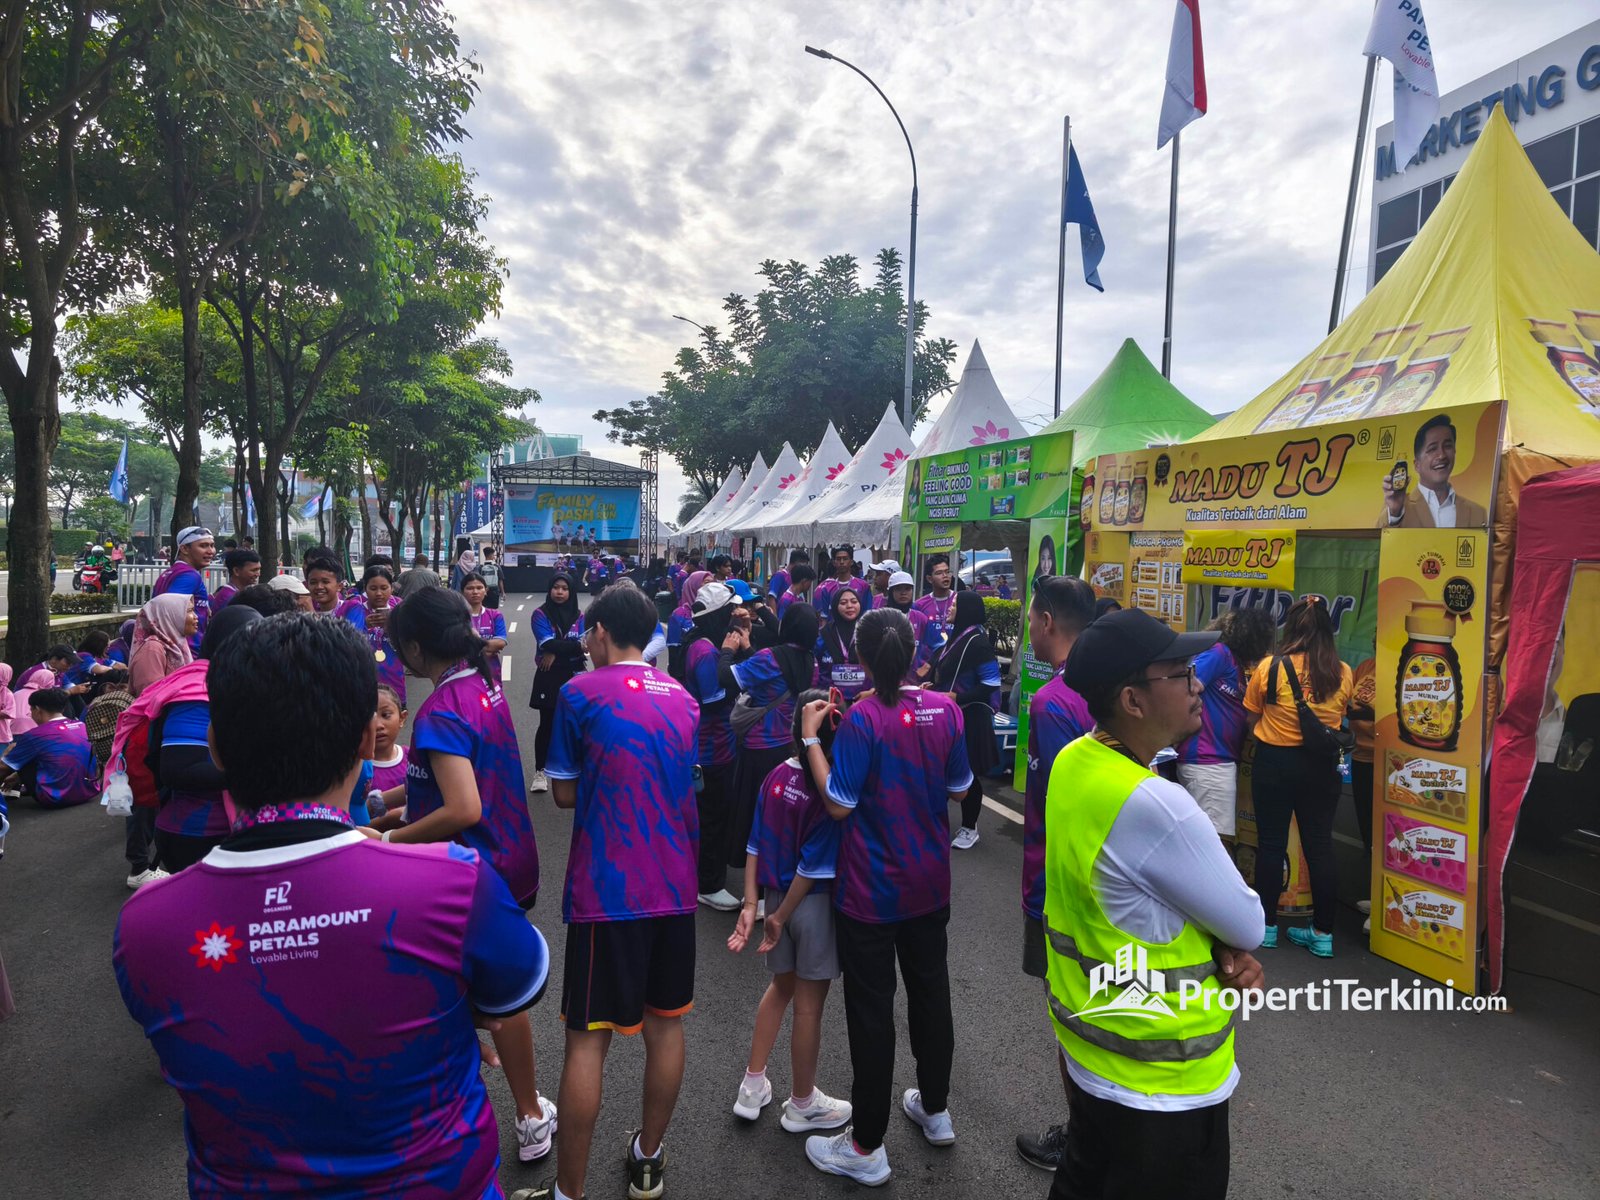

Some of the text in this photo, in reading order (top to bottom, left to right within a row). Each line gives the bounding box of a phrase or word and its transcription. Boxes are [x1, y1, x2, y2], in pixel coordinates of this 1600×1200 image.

[961, 462, 970, 473] LO
[1169, 461, 1270, 503] MADU
[1273, 433, 1356, 498] TJ
[924, 478, 949, 493] FEELING
[950, 475, 973, 491] GOOD
[537, 491, 596, 511] FAMILY
[950, 492, 968, 504] CUMA
[553, 508, 595, 524] DASH
[929, 505, 960, 518] NGISI PERUT
[1186, 504, 1308, 521] Kualitas Terbaik dari Alam
[1133, 537, 1156, 547] HARGA
[1185, 547, 1244, 566] MADU
[1245, 538, 1286, 568] TJ
[1223, 569, 1243, 578] Terbaik
[1254, 571, 1268, 579] Alam
[1448, 584, 1471, 594] 100%
[1449, 600, 1468, 608] ASLI
[1404, 679, 1451, 692] MADU TJ
[1411, 770, 1438, 779] MADU
[248, 908, 372, 936] PARAMOUNT
[249, 932, 320, 953] PETALS
[251, 949, 320, 965] Lovable Living
